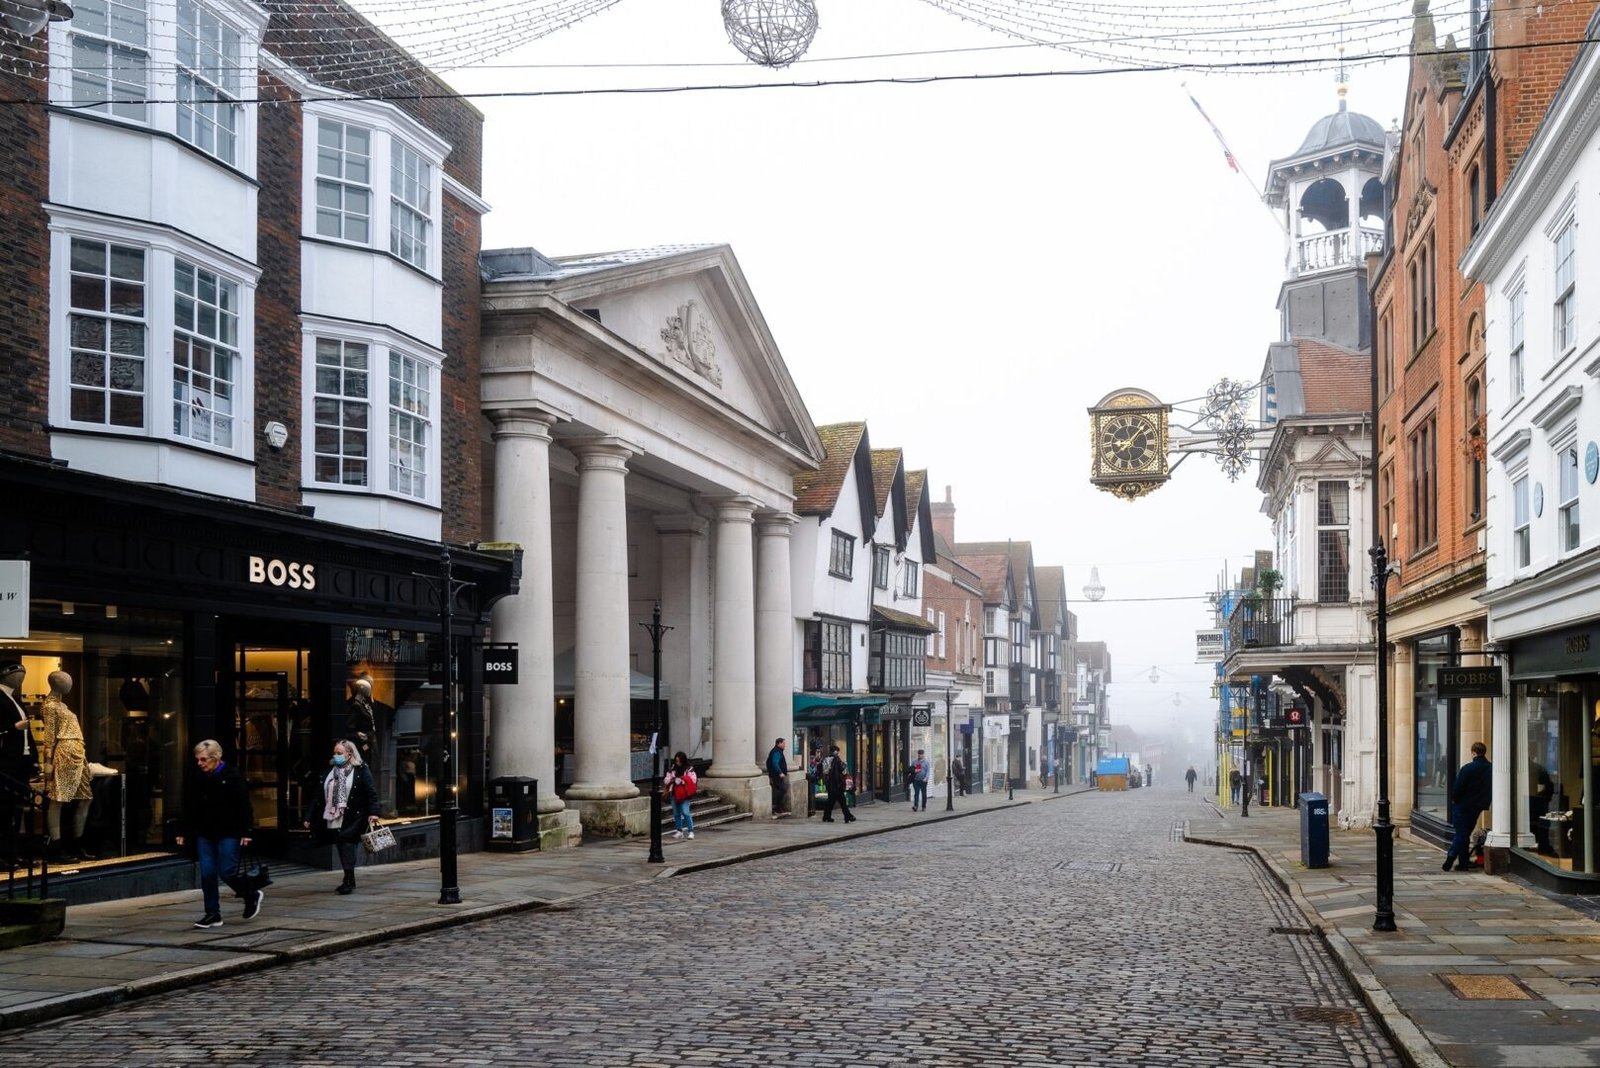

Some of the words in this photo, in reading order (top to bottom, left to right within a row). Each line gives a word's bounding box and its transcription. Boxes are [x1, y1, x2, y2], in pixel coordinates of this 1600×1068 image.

[249, 555, 316, 590] BOSS
[485, 662, 513, 671] BOSS
[1443, 672, 1496, 686] HOBBS
